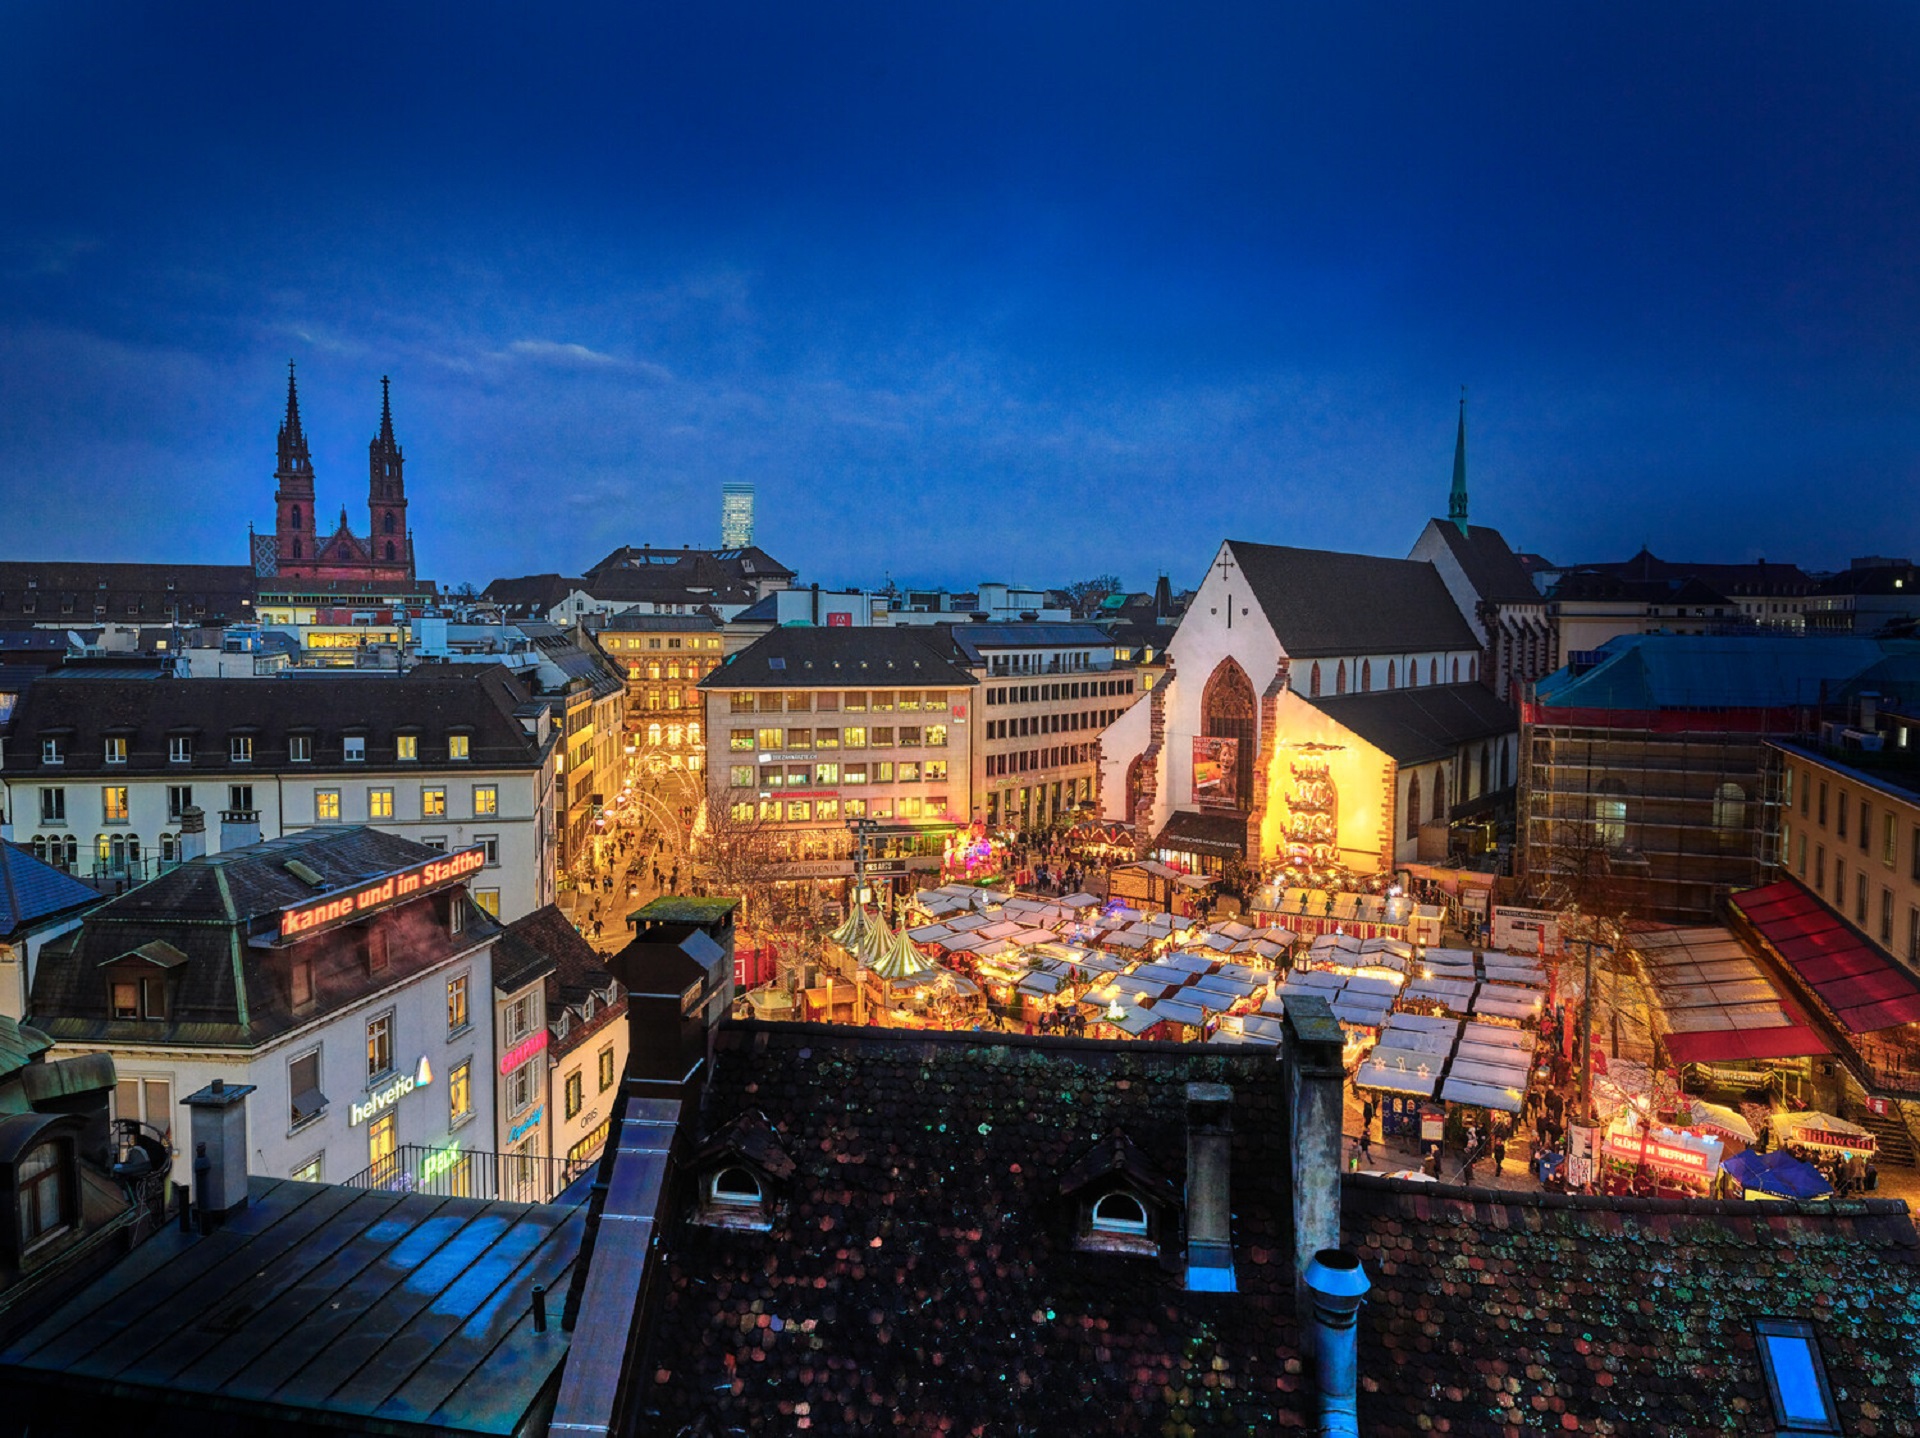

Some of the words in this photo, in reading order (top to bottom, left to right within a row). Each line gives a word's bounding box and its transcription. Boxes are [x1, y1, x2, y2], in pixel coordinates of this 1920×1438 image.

[357, 878, 394, 909] und
[397, 873, 420, 896] im
[422, 851, 484, 886] Stadtho
[350, 1075, 414, 1126] helvetia
